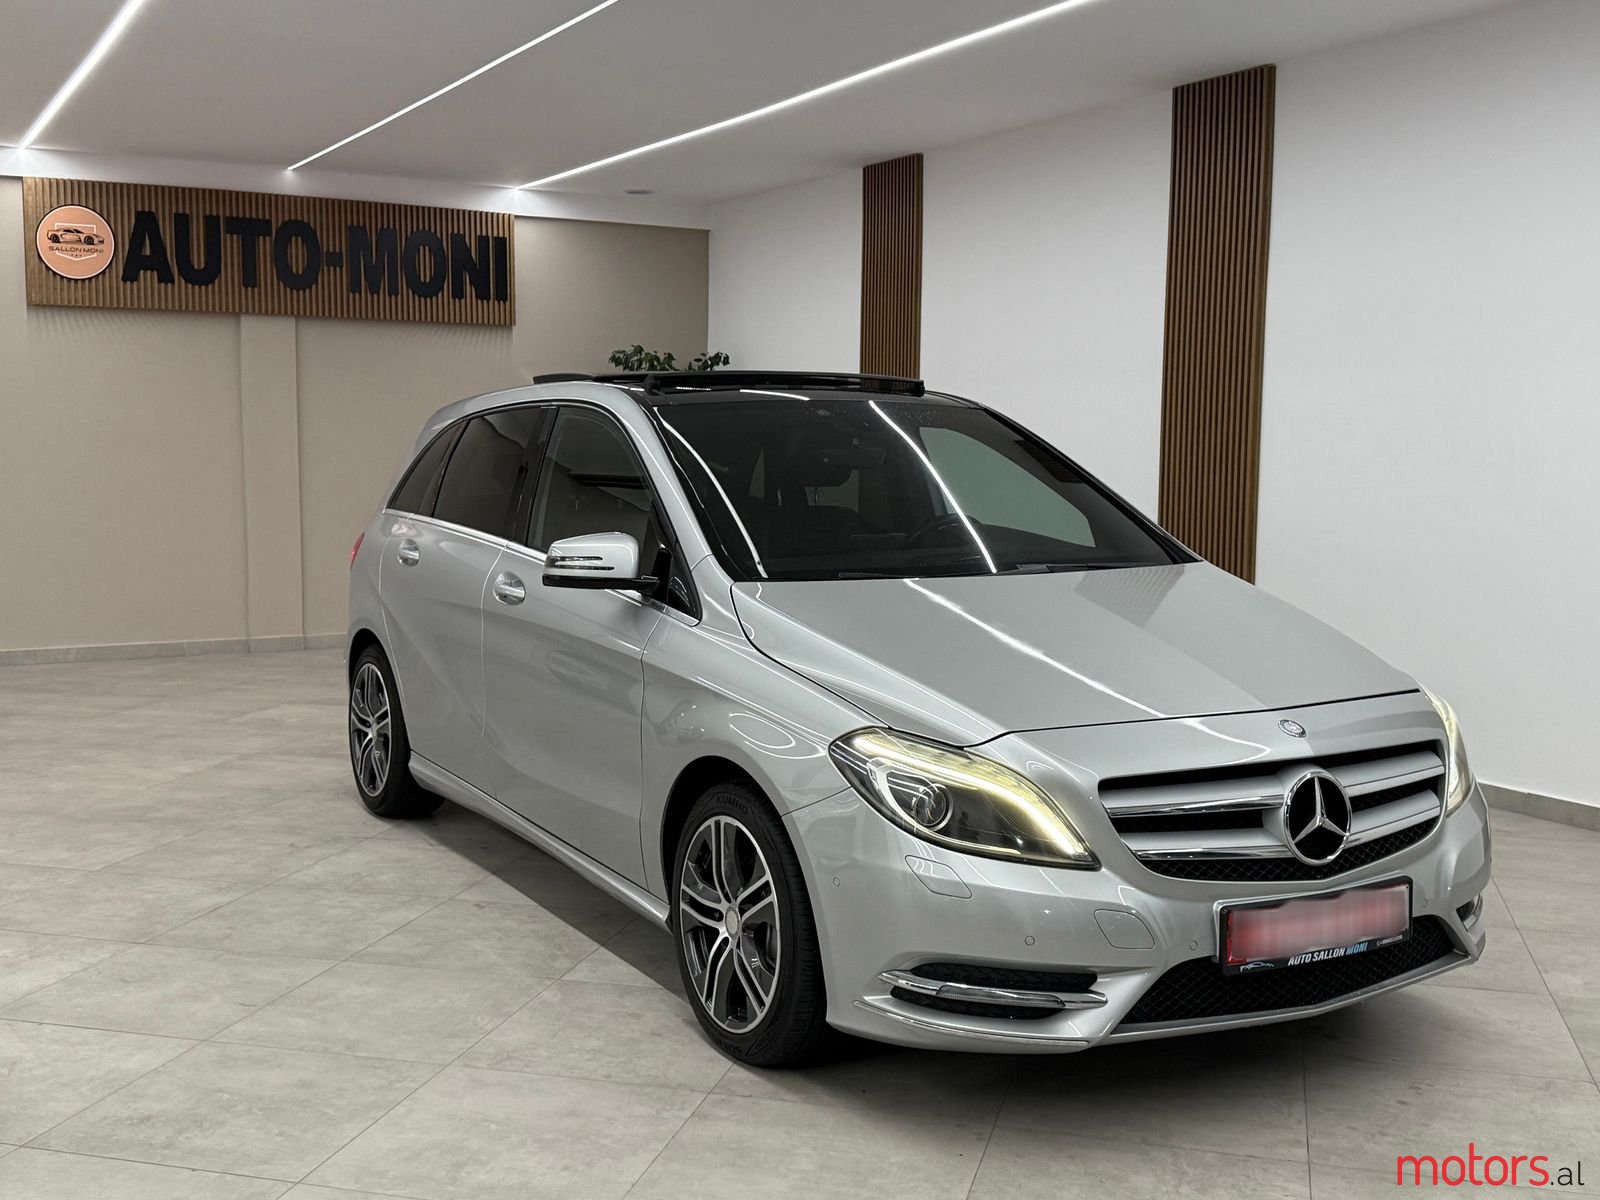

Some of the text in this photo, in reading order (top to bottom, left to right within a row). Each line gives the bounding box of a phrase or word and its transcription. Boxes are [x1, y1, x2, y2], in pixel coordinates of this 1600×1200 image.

[49, 245, 82, 253] SALLON
[121, 210, 508, 303] AUTO-MONI
[716, 795, 748, 815] KUMHO
[1287, 942, 1368, 966] AUTO SALLON MONI
